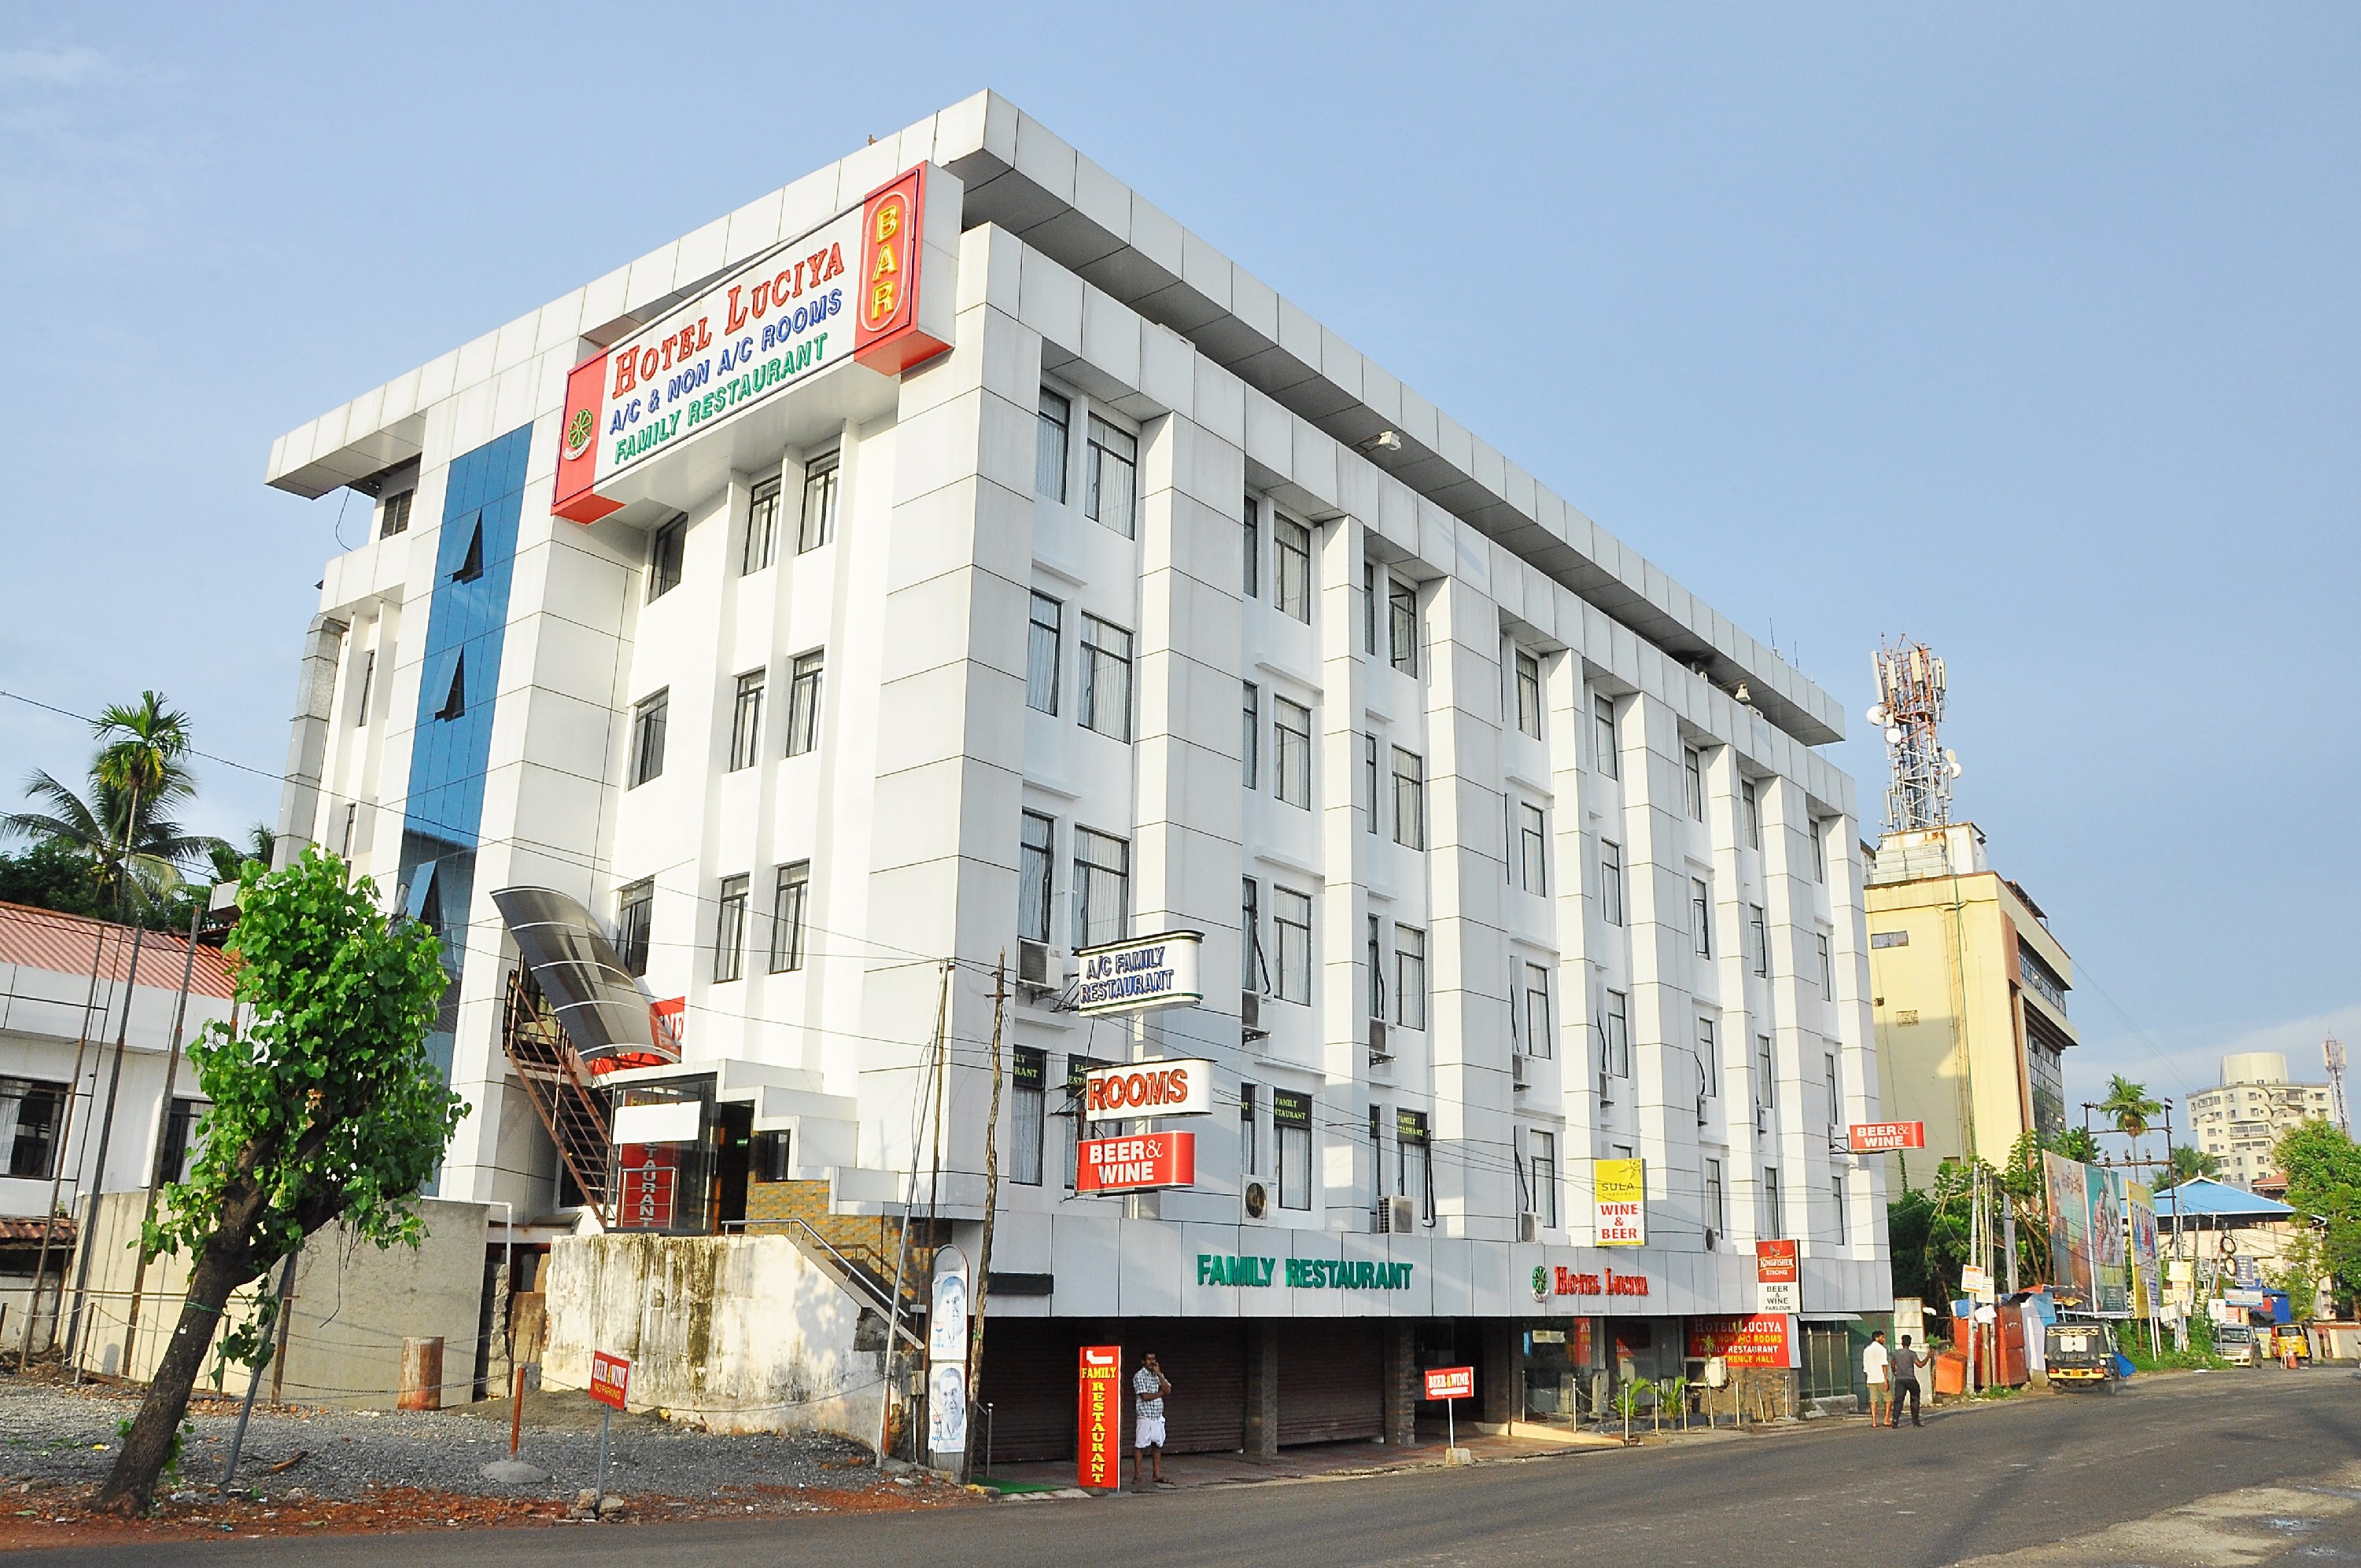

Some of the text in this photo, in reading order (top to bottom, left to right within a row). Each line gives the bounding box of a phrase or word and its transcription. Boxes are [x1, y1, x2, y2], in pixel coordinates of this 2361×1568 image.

[871, 205, 898, 320] BAR
[612, 242, 844, 400] HOTEL LUCIYA
[610, 289, 843, 434] A/C & NON A/C ROOMS
[614, 332, 828, 465] FAMILY RESTAURANT
[1086, 946, 1165, 980] A/C FAMILY
[1080, 969, 1174, 1004] RESTAURANT
[1088, 1068, 1188, 1111] ROOMS
[1275, 1097, 1297, 1108] FAMILY
[1864, 1135, 1905, 1147] WINE
[1098, 1160, 1154, 1184] WINE
[1601, 1182, 1634, 1191] SULA
[1600, 1204, 1638, 1216] WINE
[1614, 1216, 1623, 1227] &
[1601, 1228, 1637, 1239] BEER
[1197, 1254, 1414, 1289] FAMILY RESTAURANT
[1555, 1265, 1601, 1295] HOTEL
[1728, 1345, 1778, 1353] RESTAURANT
[1754, 1334, 1782, 1343] ROOMS
[1755, 1354, 1775, 1363] HALL
[1082, 1367, 1116, 1379] FAMILY
[595, 1382, 621, 1400] NO PARKING
[1091, 1382, 1105, 1483] RESTAURANT
